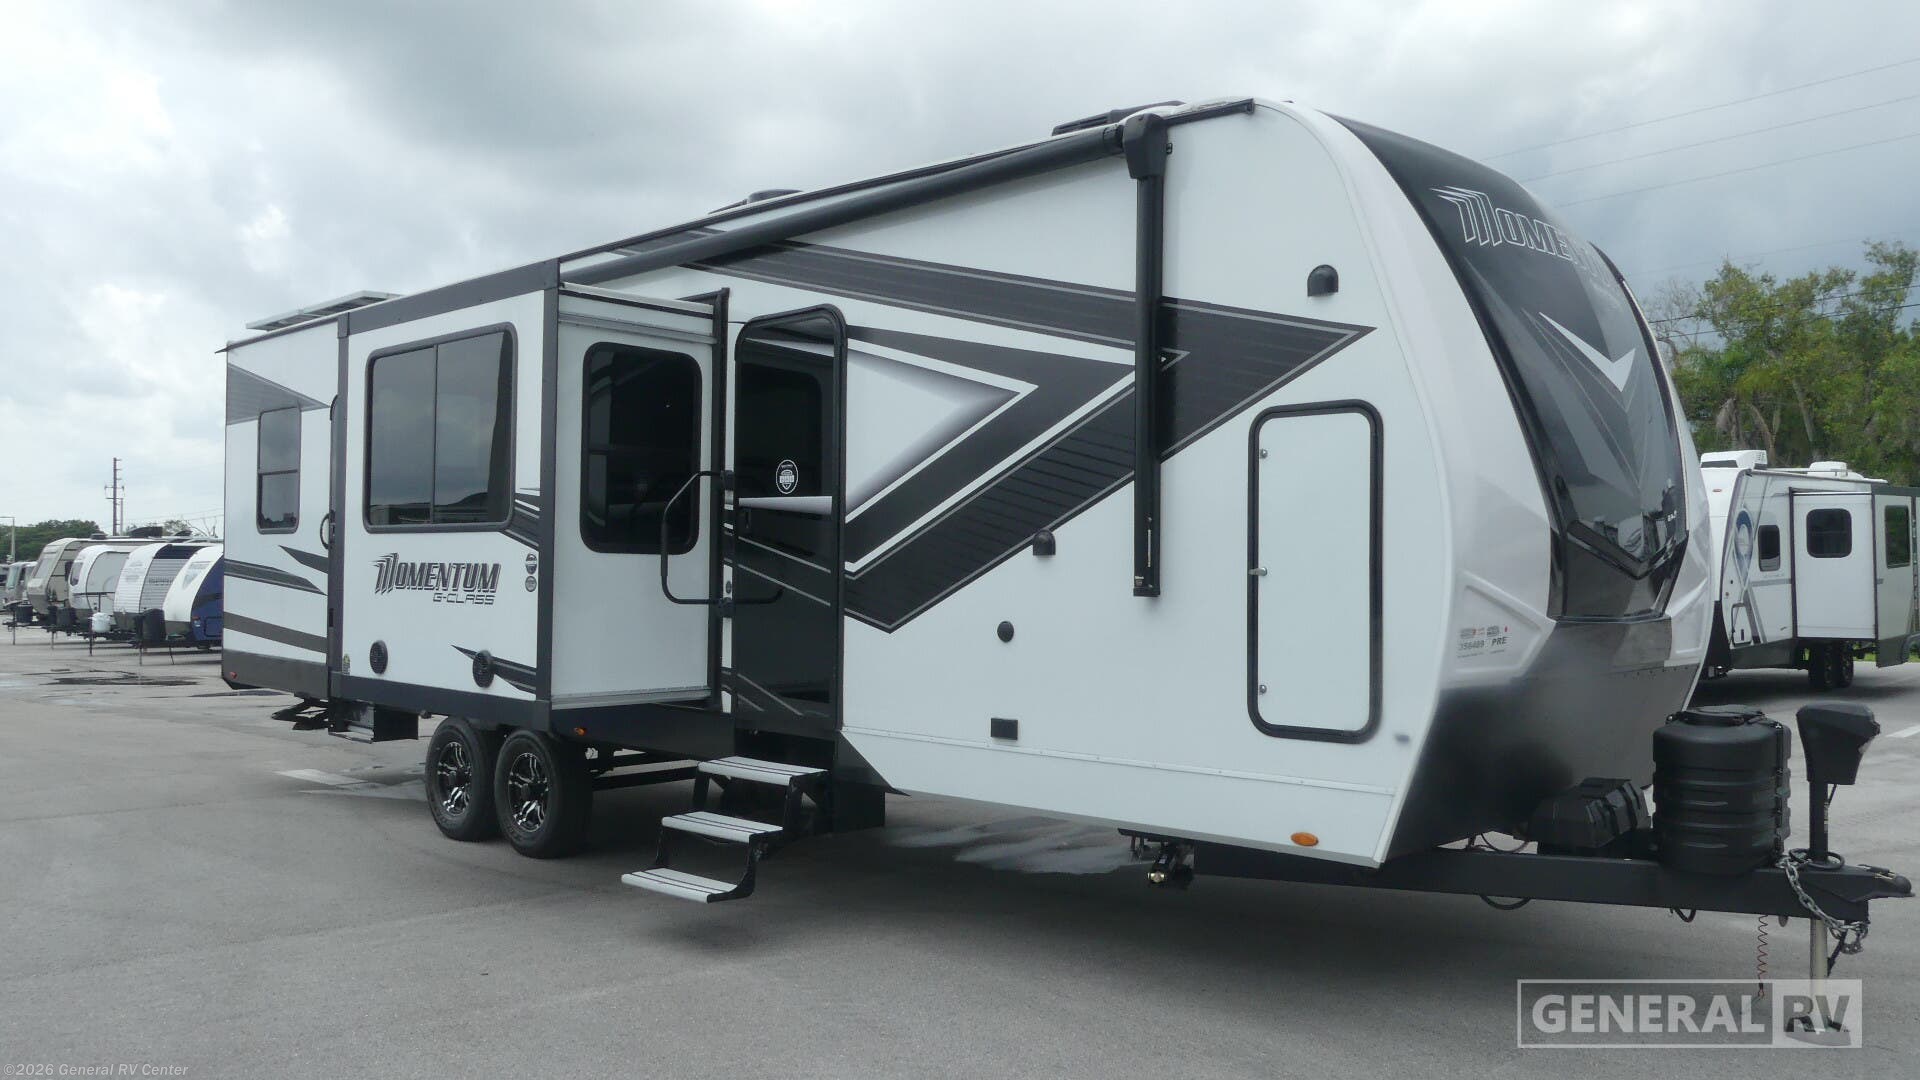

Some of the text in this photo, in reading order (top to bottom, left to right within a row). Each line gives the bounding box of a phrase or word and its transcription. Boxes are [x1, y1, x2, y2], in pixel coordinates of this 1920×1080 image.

[1430, 185, 1602, 280] MOME
[370, 552, 501, 594] MOMENTUM
[432, 592, 496, 606] G-CLASS
